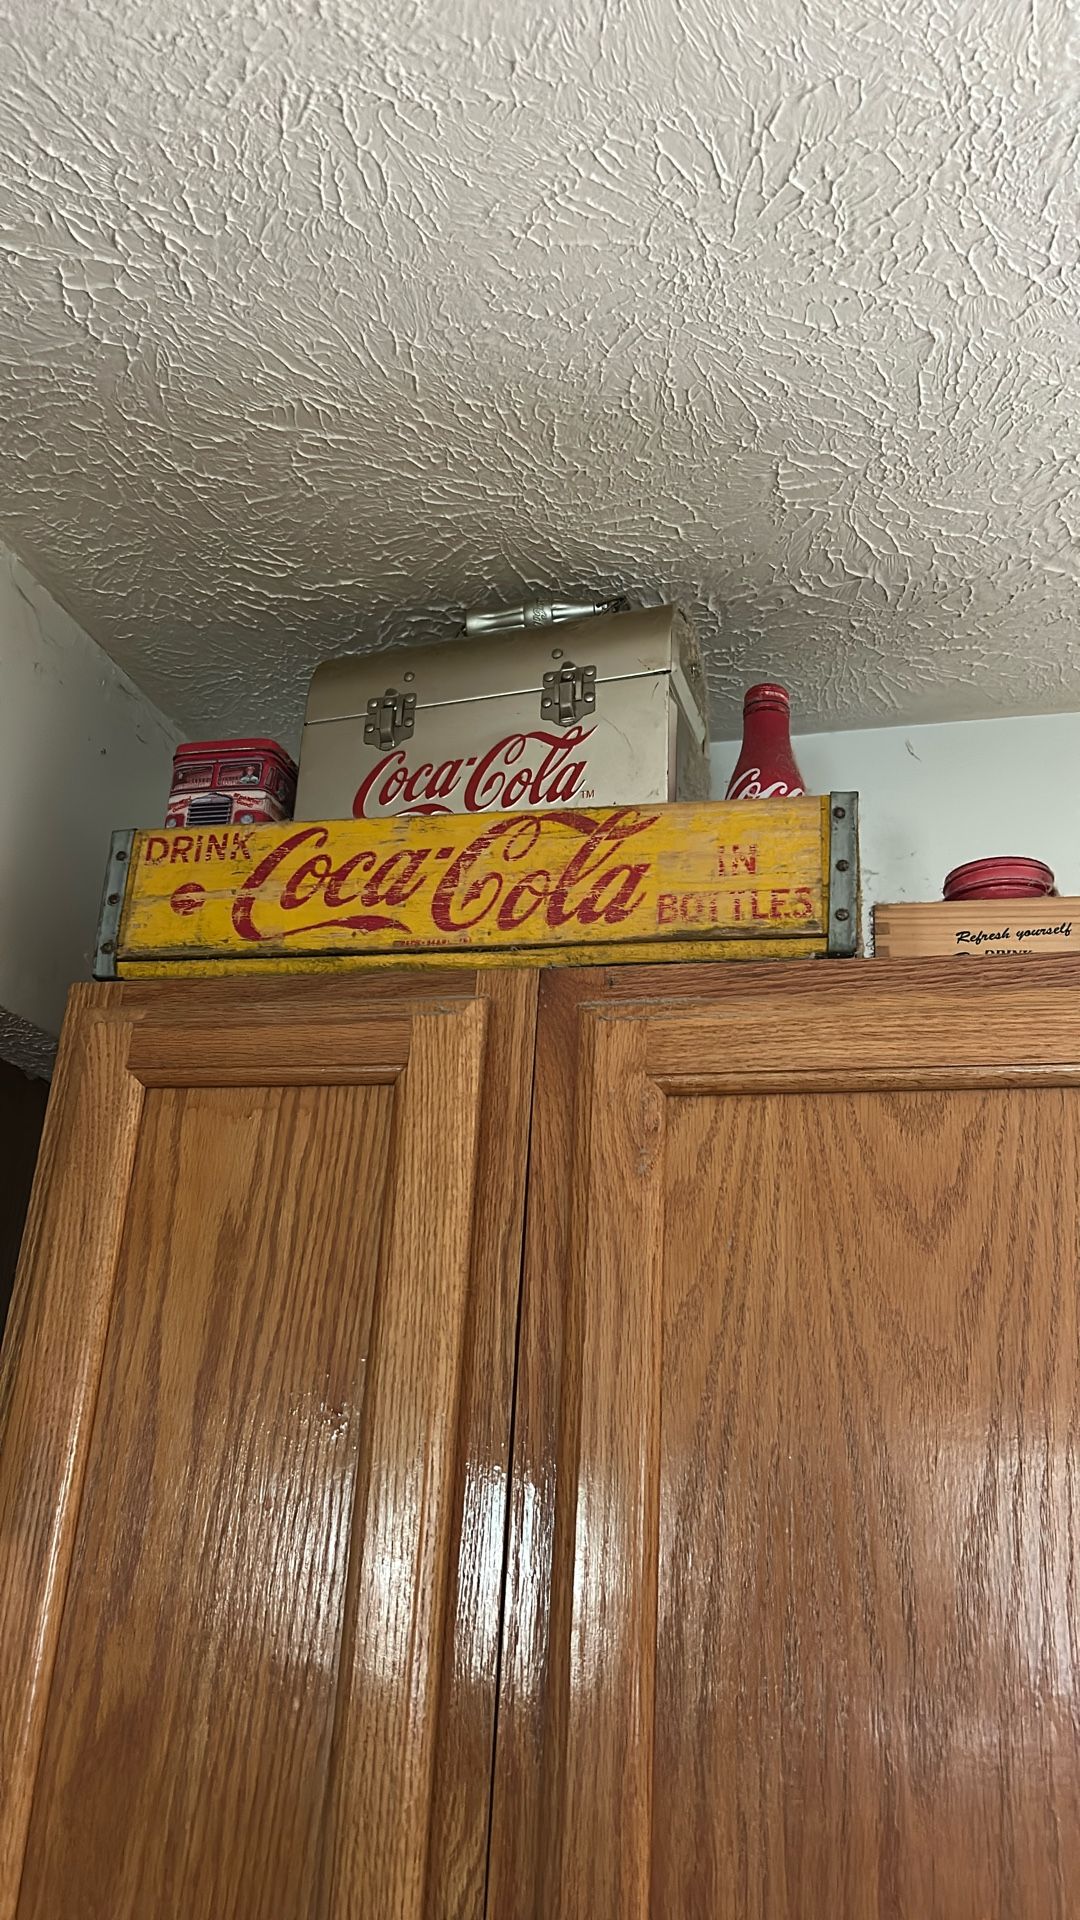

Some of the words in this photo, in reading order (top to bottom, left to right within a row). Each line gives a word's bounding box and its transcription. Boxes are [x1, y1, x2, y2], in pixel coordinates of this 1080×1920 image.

[353, 725, 598, 819] Coca-Cola
[144, 832, 255, 865] DRINK
[718, 844, 758, 876] IN
[232, 807, 661, 941] Coca-Cola
[657, 887, 813, 925] BOTTLES
[955, 927, 1010, 945] Refresh
[1016, 922, 1072, 941] yourself
